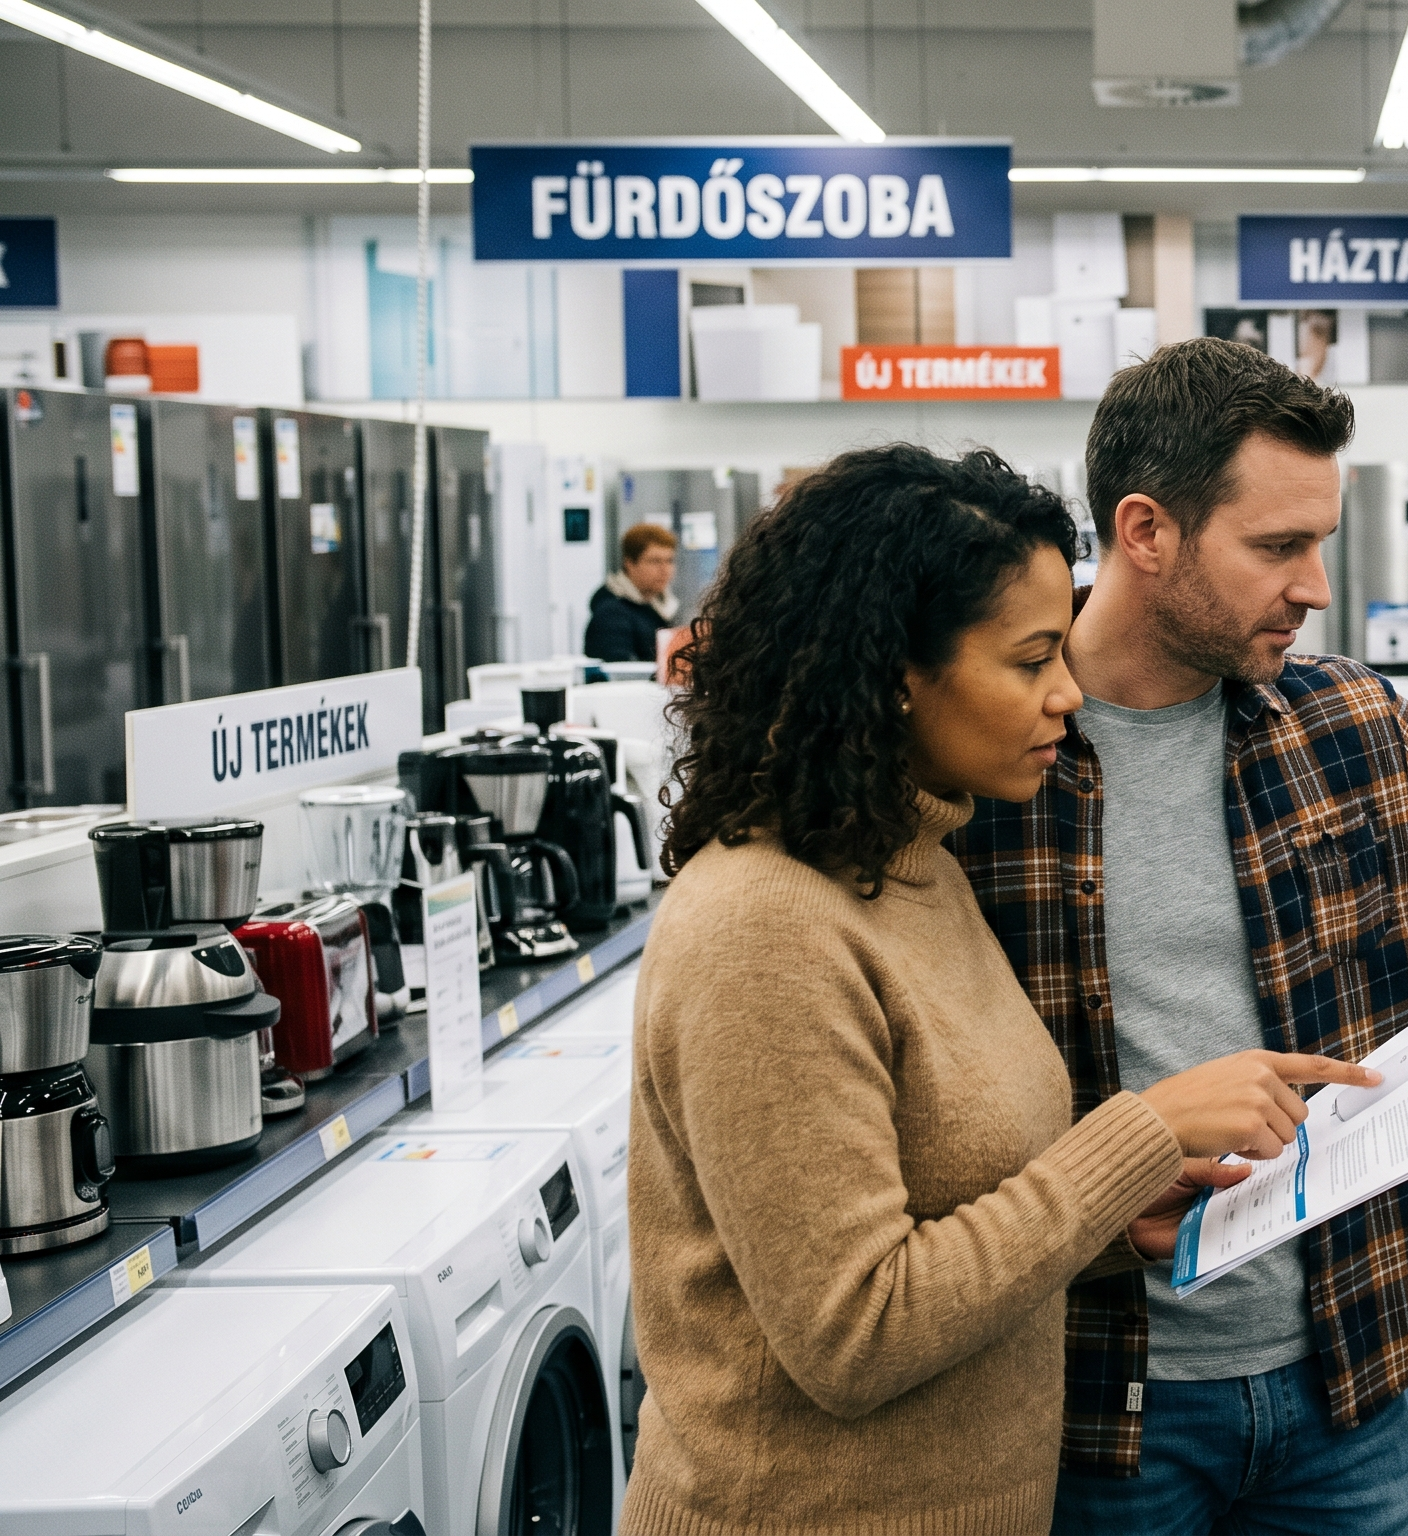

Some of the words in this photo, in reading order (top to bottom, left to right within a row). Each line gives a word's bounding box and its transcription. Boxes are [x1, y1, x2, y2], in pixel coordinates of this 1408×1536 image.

[531, 158, 956, 242] FÜRDŐSZOBA
[855, 351, 893, 390] ÚJ
[897, 351, 1048, 389] TERMÉKEK
[212, 713, 242, 782] ÚJ
[250, 696, 370, 774] TERMÉKEK
